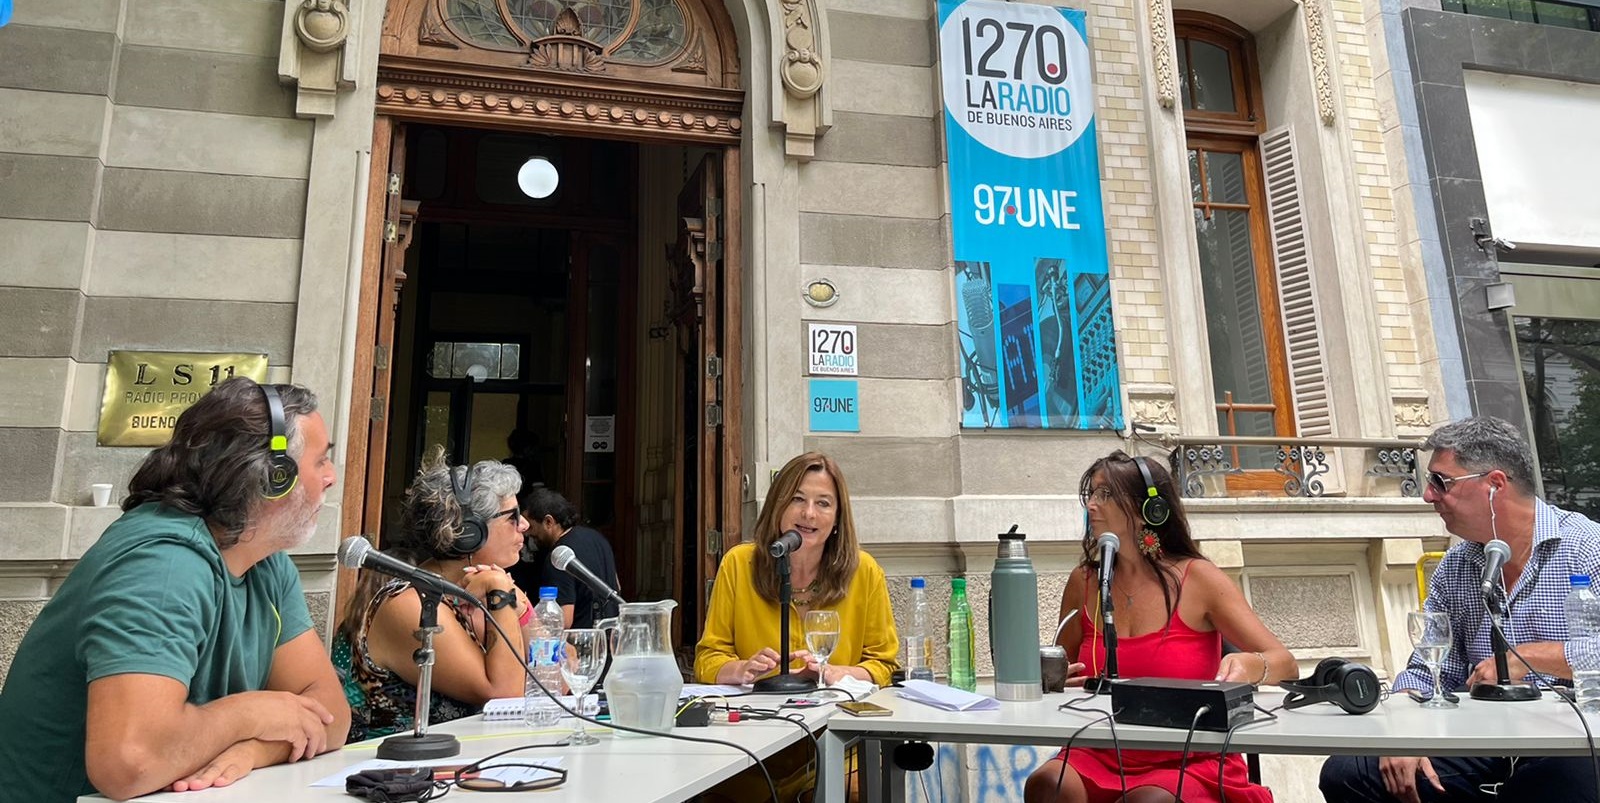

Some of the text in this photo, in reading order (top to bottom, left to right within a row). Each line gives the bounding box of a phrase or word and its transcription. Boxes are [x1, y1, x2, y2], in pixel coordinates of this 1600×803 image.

[962, 17, 1068, 85] 1270
[967, 111, 1073, 132] DE BUENOS AIRES
[812, 329, 853, 355] 1270
[134, 363, 156, 386] L
[172, 364, 194, 386] S
[125, 391, 201, 404] RADIO PRO
